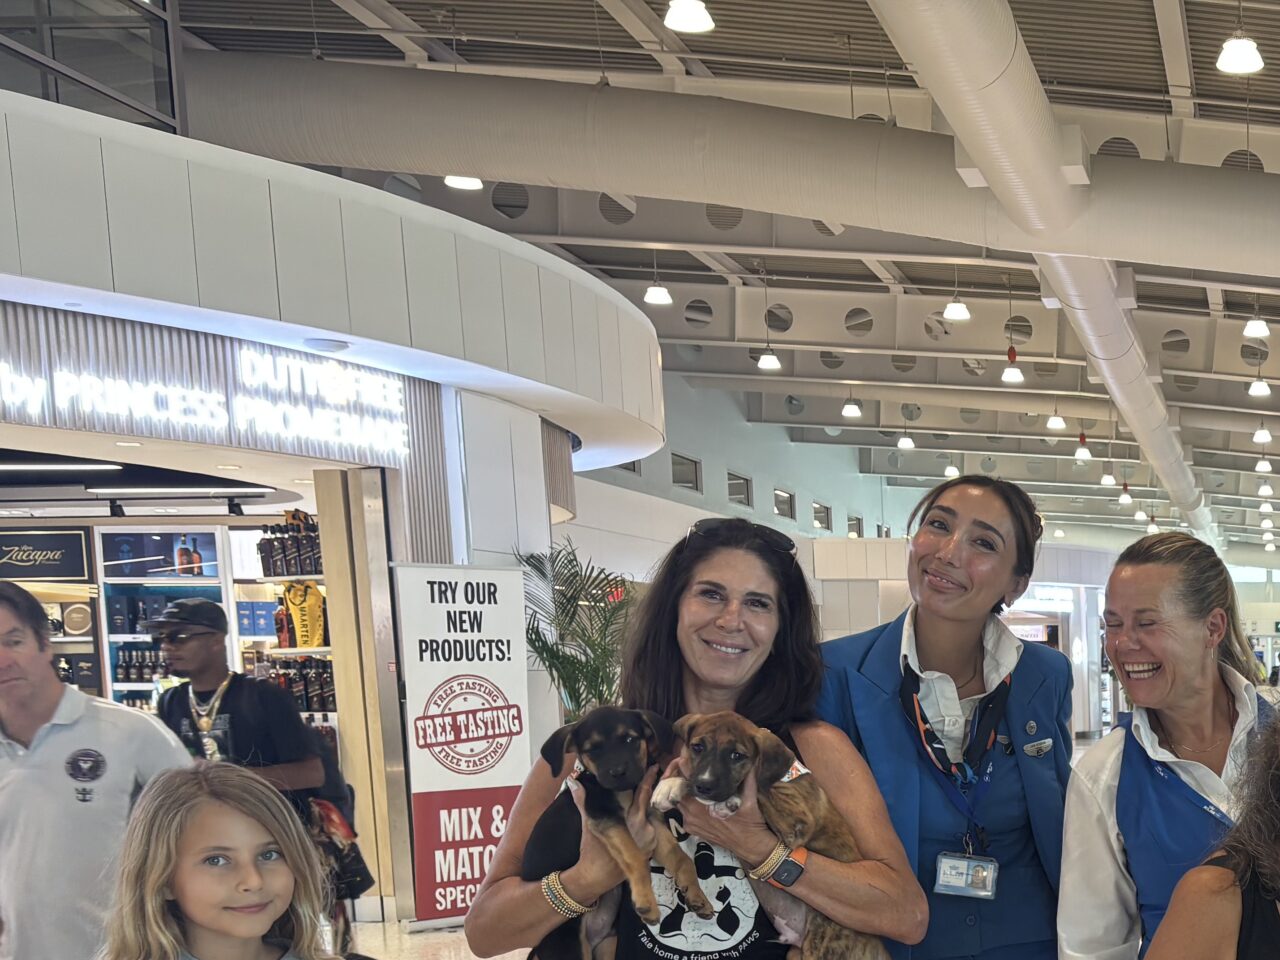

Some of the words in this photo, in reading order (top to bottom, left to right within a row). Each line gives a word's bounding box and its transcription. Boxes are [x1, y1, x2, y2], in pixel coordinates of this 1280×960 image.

[54, 368, 229, 431] PRINCESS
[0, 546, 63, 566] Zacapa
[427, 580, 458, 604] TRY
[464, 581, 498, 605] OUR
[299, 606, 310, 645] MAARTEN
[446, 610, 483, 633] NEW
[418, 639, 512, 662] PRODUCTS!
[433, 685, 457, 709] FREE
[457, 681, 500, 704] TASTING
[416, 716, 455, 746] FREE
[456, 707, 521, 740] TASTING
[437, 747, 461, 767] FREE
[464, 741, 504, 768] TASTING
[439, 806, 484, 842] MIX
[490, 804, 507, 838] &
[434, 844, 497, 883] MATC
[738, 930, 760, 953] PAWS
